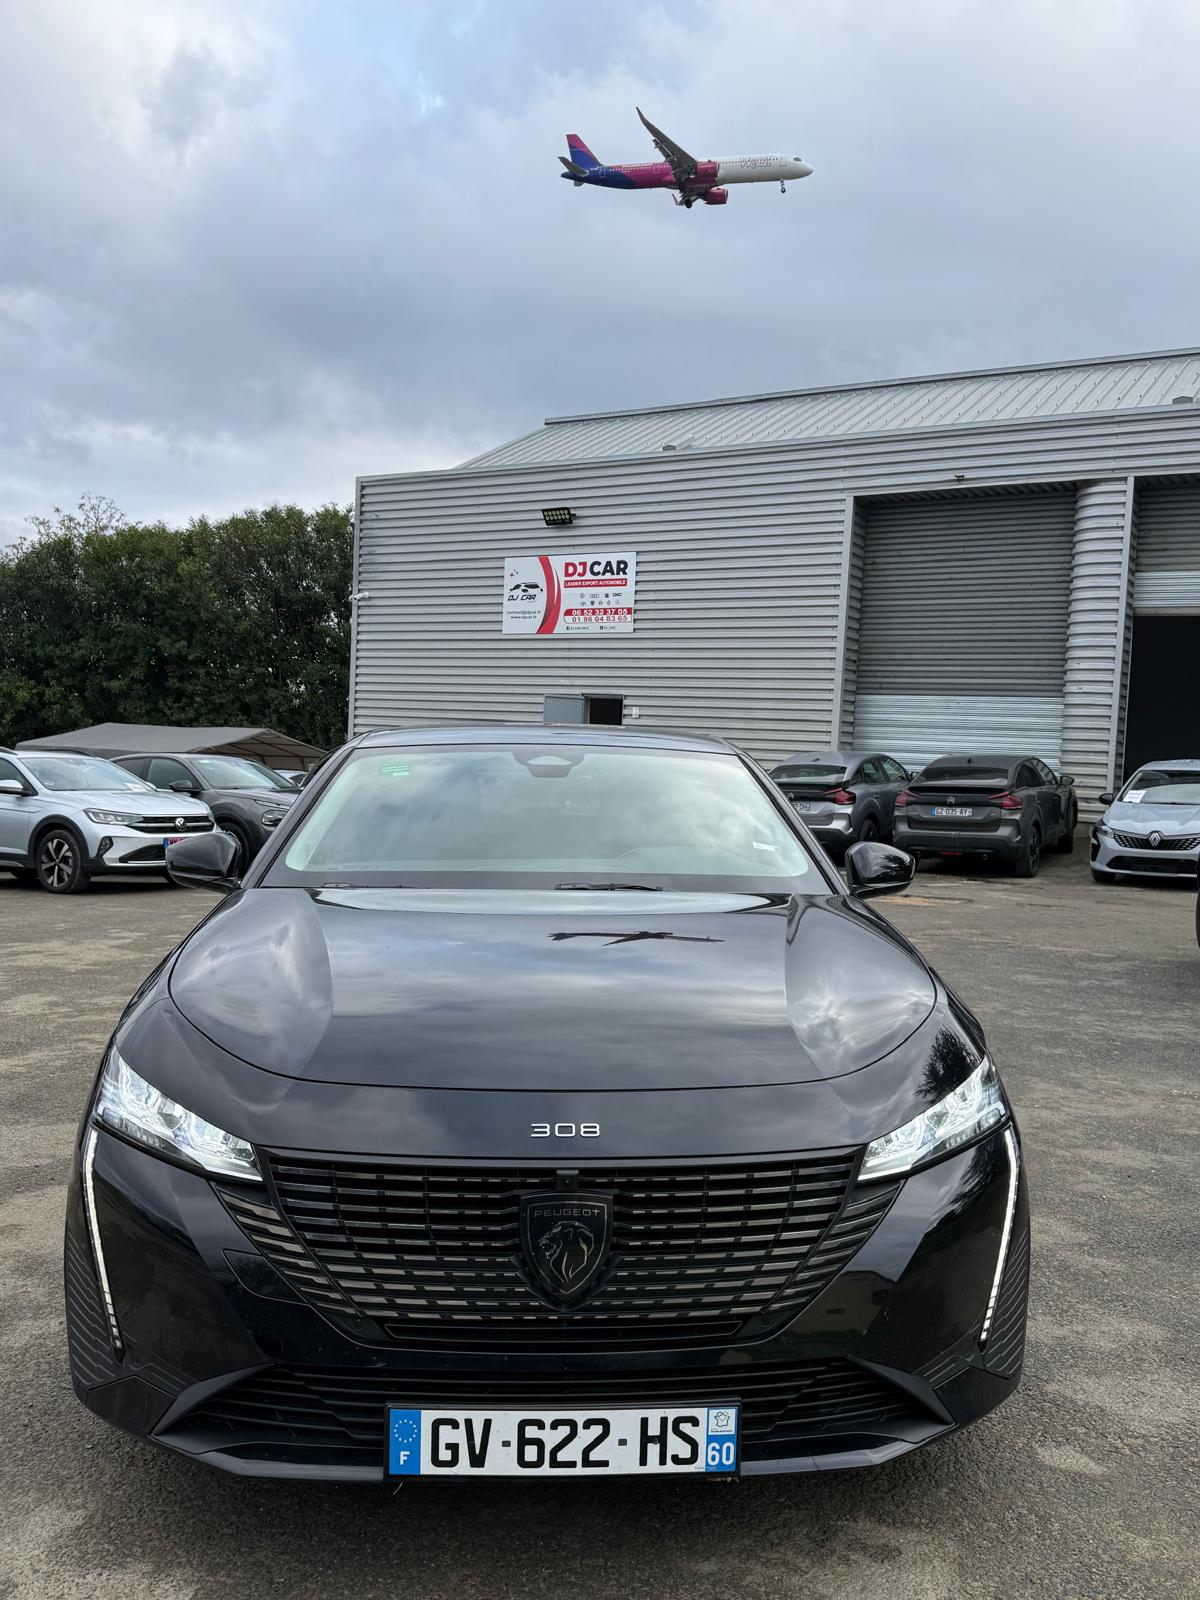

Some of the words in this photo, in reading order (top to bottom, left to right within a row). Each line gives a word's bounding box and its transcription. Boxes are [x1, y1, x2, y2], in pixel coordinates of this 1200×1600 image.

[530, 1122, 600, 1138] 308
[534, 1208, 600, 1217] PEUGEOT
[399, 1450, 411, 1466] F
[707, 1441, 735, 1466] 60
